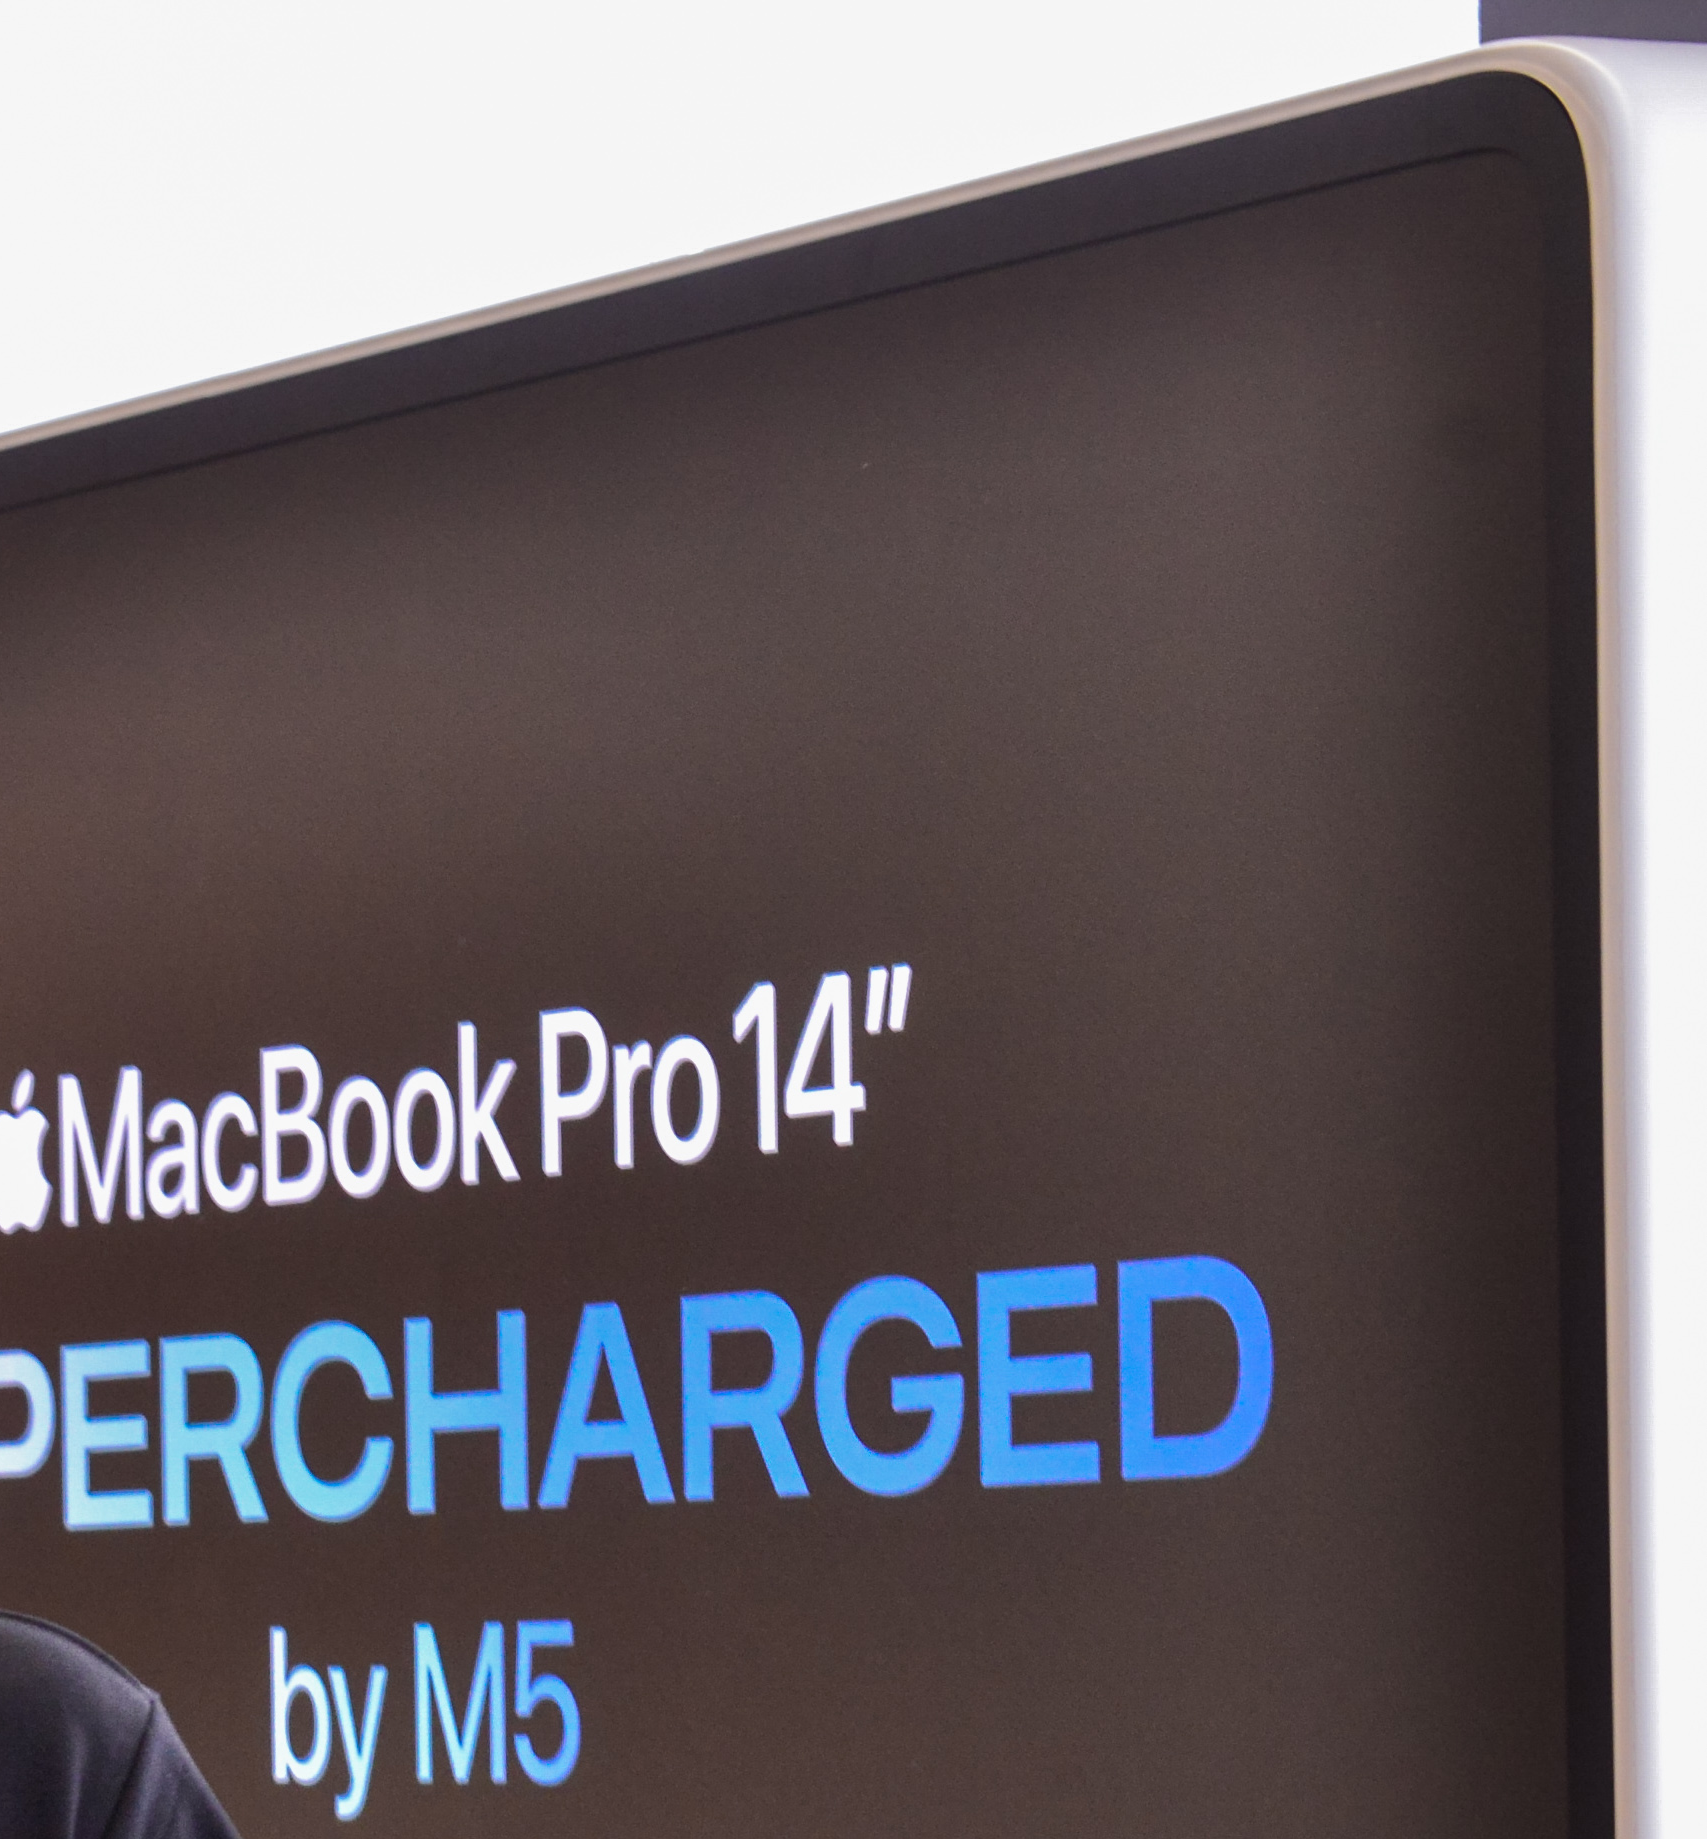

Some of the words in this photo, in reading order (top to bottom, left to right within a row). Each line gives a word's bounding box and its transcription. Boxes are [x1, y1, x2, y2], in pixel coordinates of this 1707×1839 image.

[58, 1022, 522, 1228] MacBook
[540, 1009, 721, 1178] Pro
[269, 1625, 389, 1822] by
[414, 1619, 581, 1788] M5
